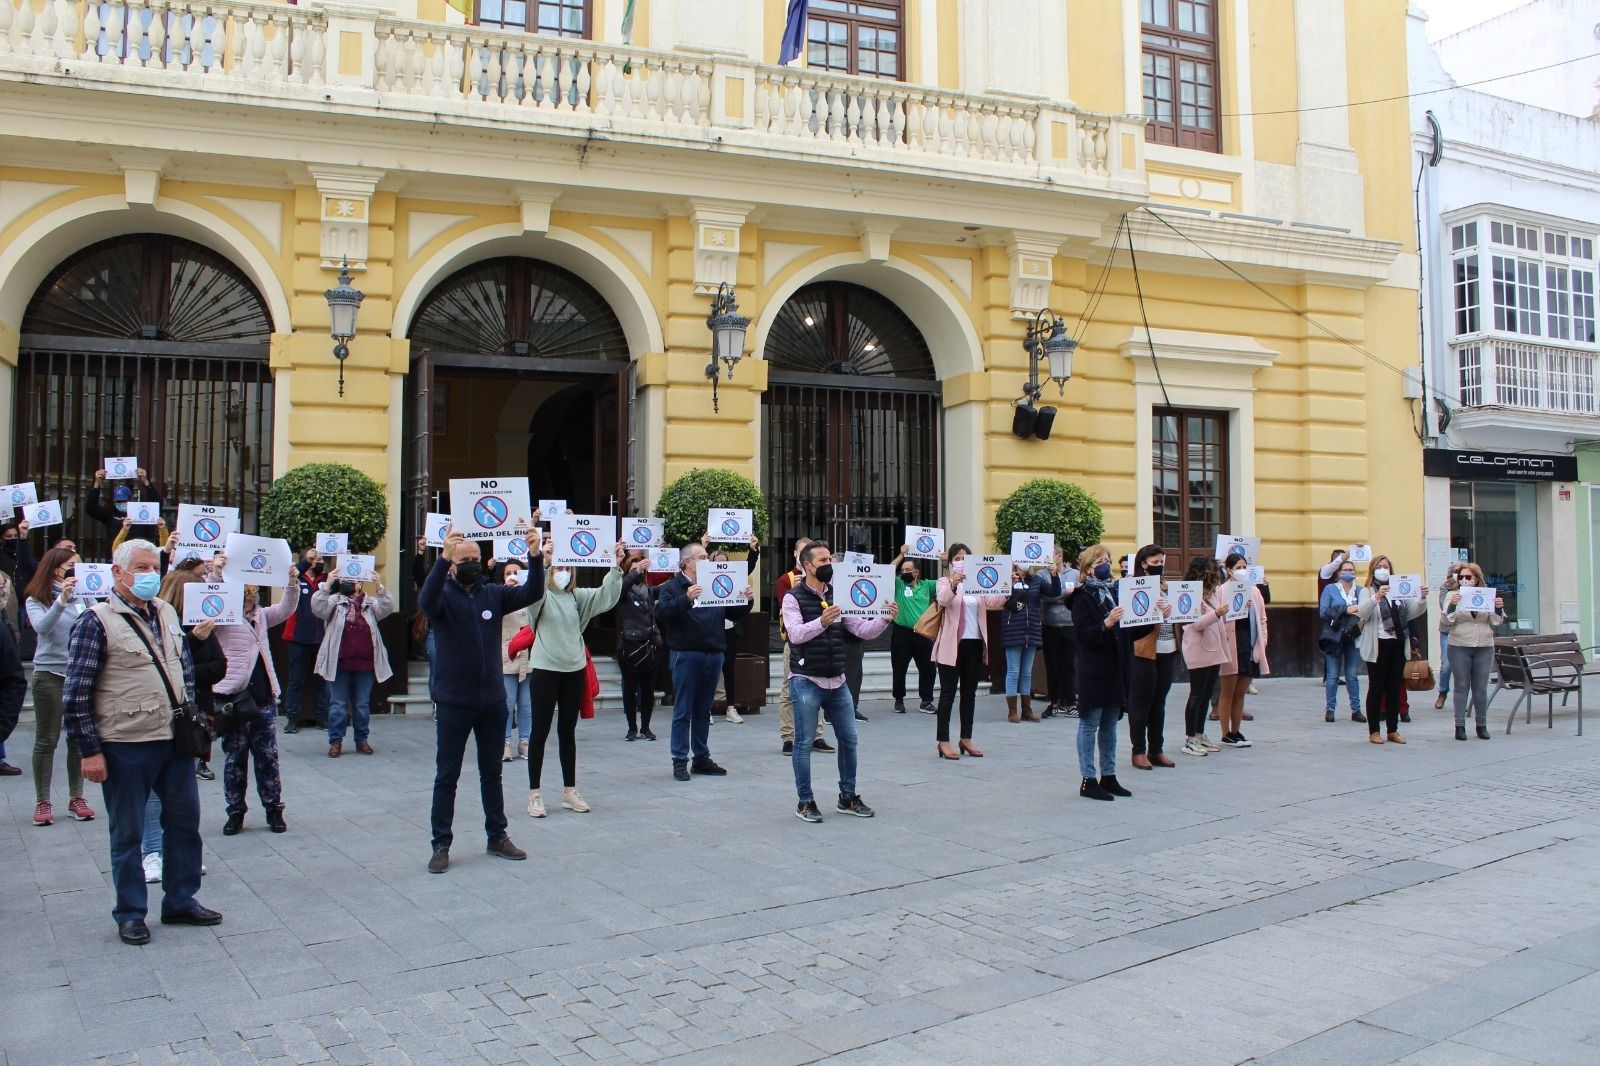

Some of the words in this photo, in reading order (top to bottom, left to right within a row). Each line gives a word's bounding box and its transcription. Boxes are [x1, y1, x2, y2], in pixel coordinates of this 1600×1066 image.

[481, 480, 498, 489] NO
[856, 565, 871, 573] NO
[1136, 578, 1146, 586] NO
